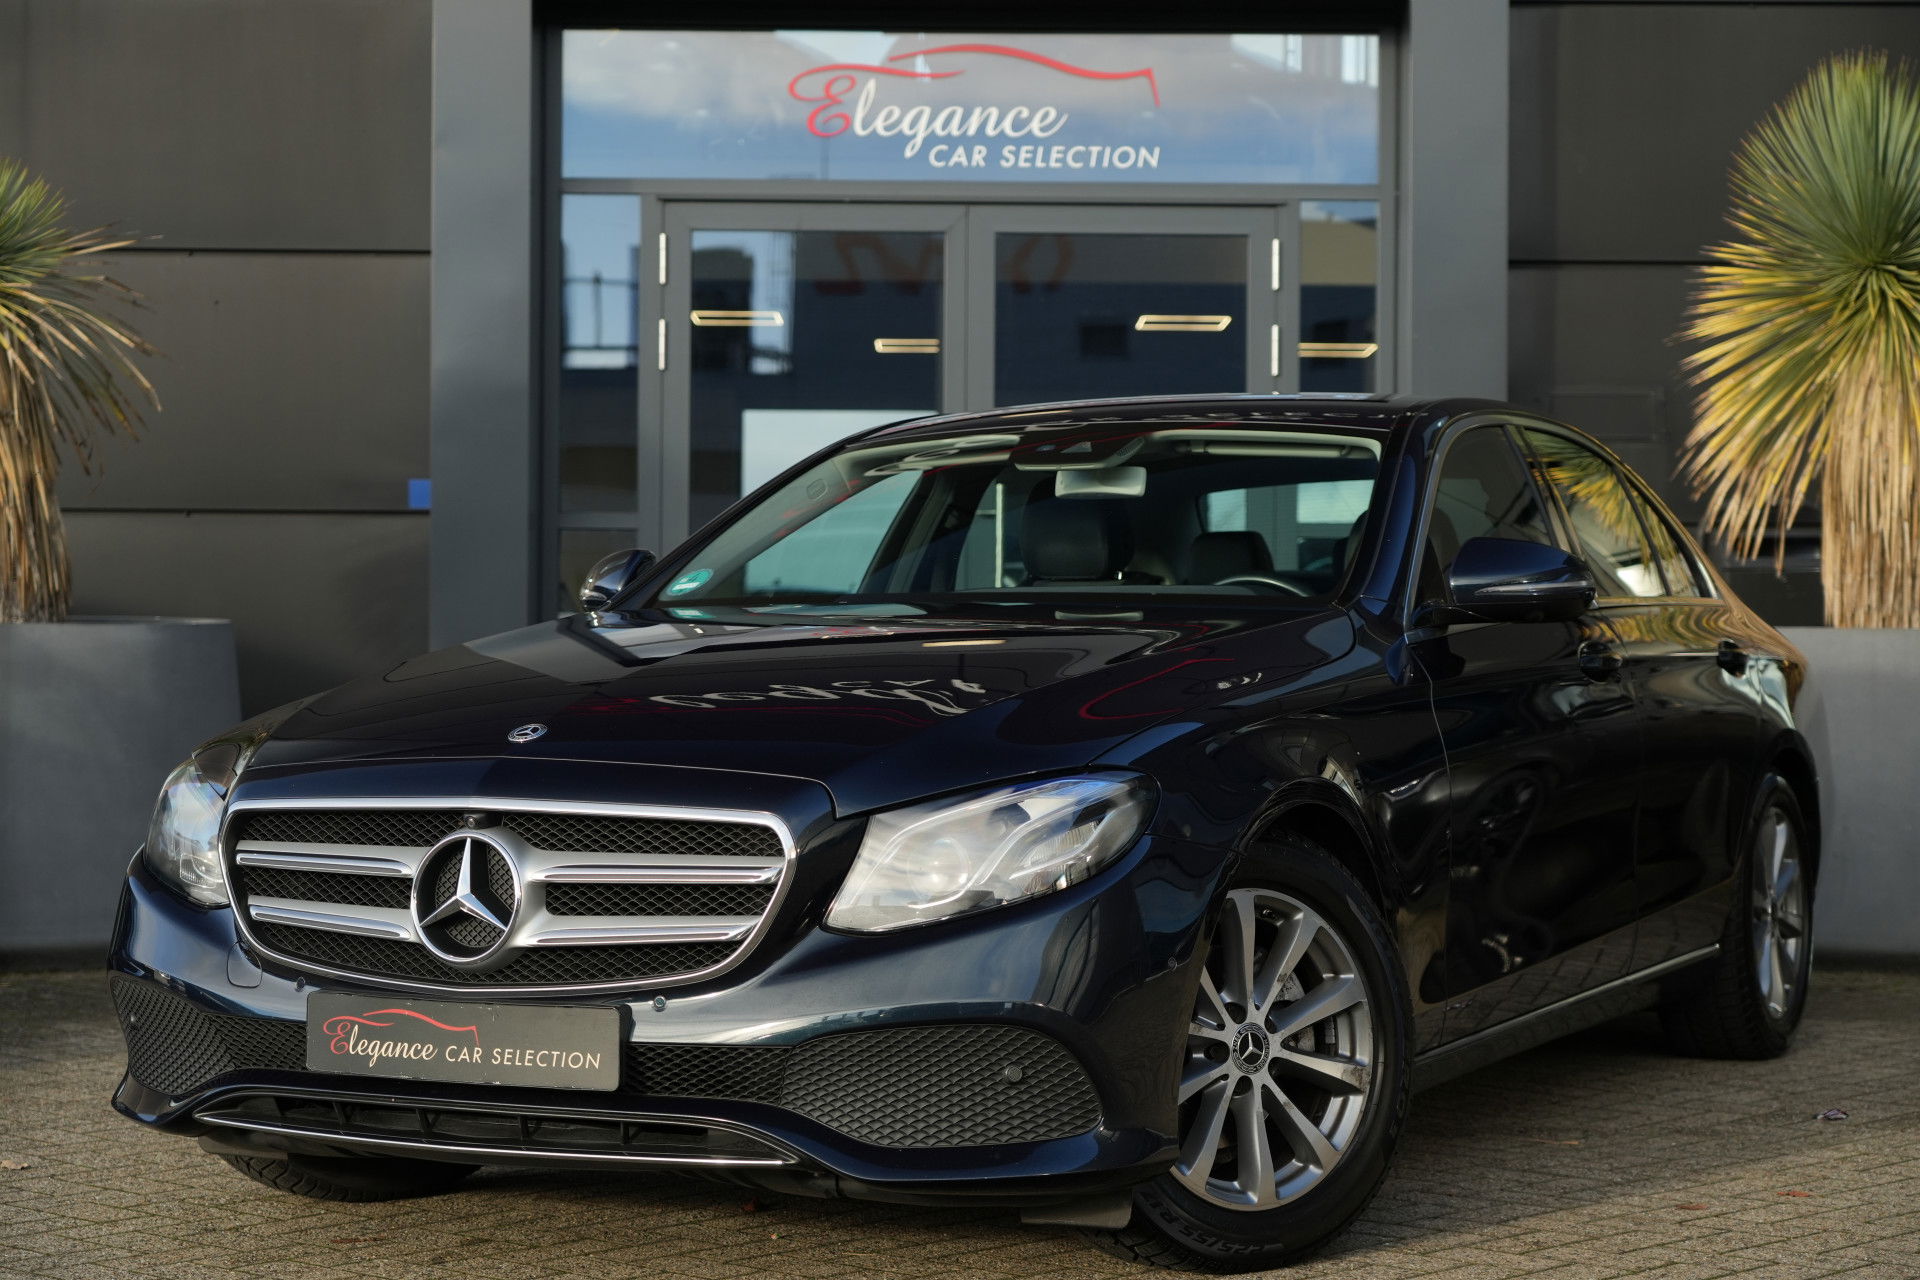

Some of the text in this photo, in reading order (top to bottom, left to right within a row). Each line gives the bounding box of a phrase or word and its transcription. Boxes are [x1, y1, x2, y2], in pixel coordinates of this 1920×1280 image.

[788, 64, 1069, 159] Elegance
[928, 144, 1161, 169] CAR SELECTION
[323, 1016, 602, 1070] Elegance CAR SELECTION
